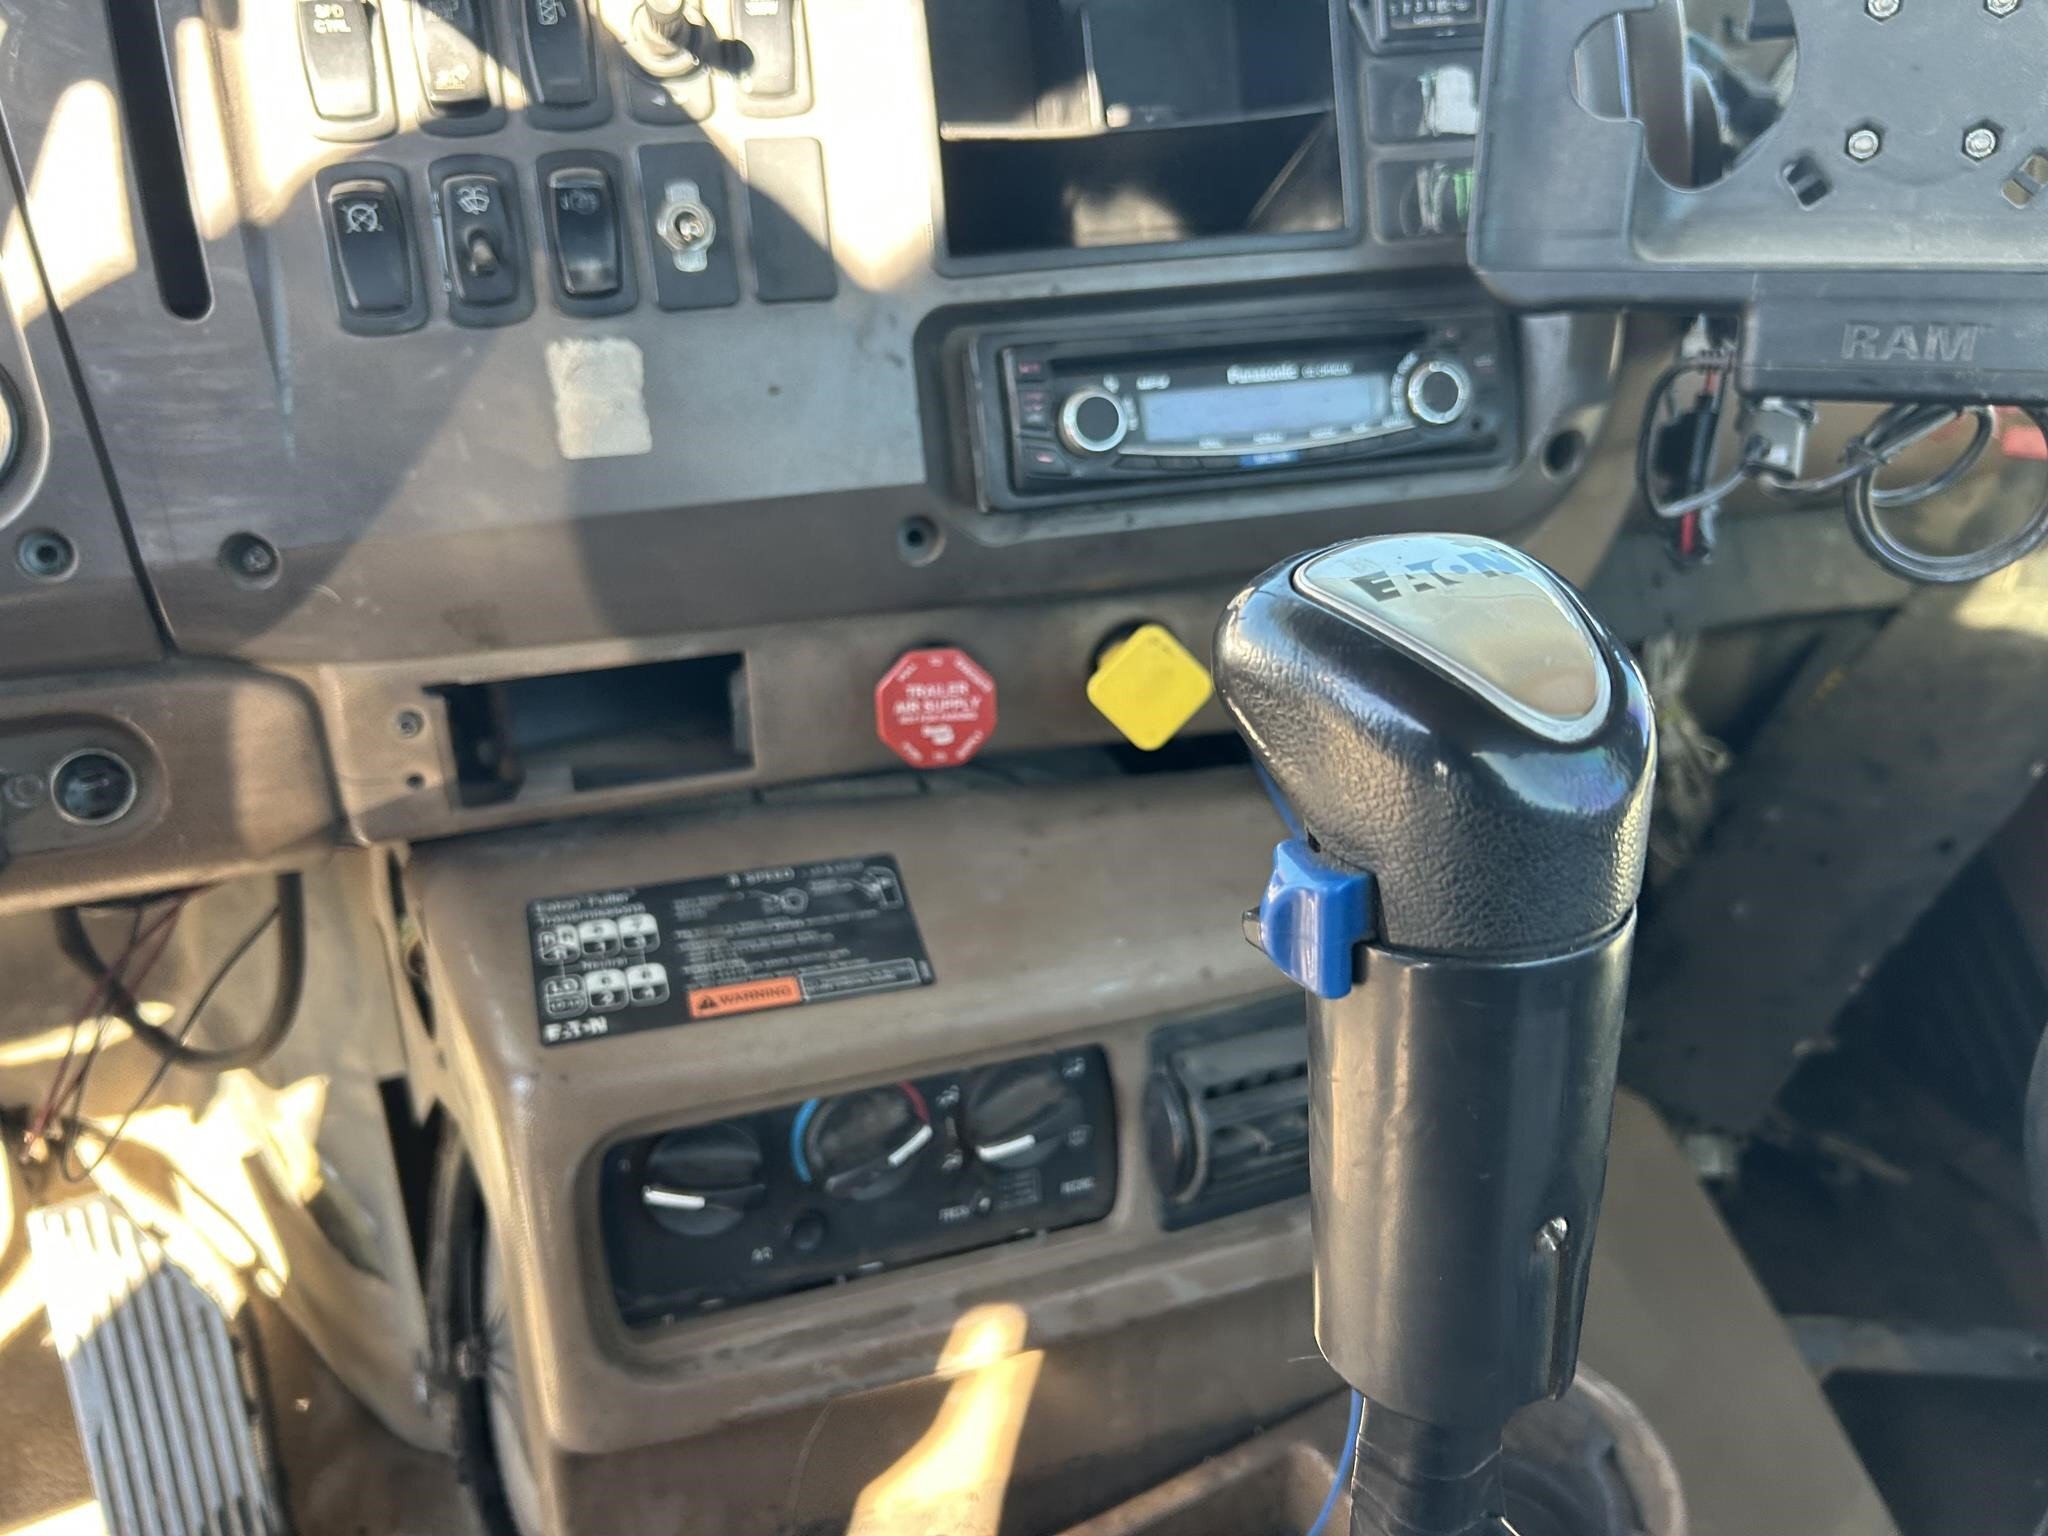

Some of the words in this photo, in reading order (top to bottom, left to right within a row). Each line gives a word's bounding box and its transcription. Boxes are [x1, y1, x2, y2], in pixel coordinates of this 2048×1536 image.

[1840, 323, 1979, 361] RAM
[1227, 364, 1299, 384] Panasonic
[906, 681, 969, 698] TRAILER
[923, 696, 982, 712] SUPPLY
[720, 984, 794, 1006] WARNING
